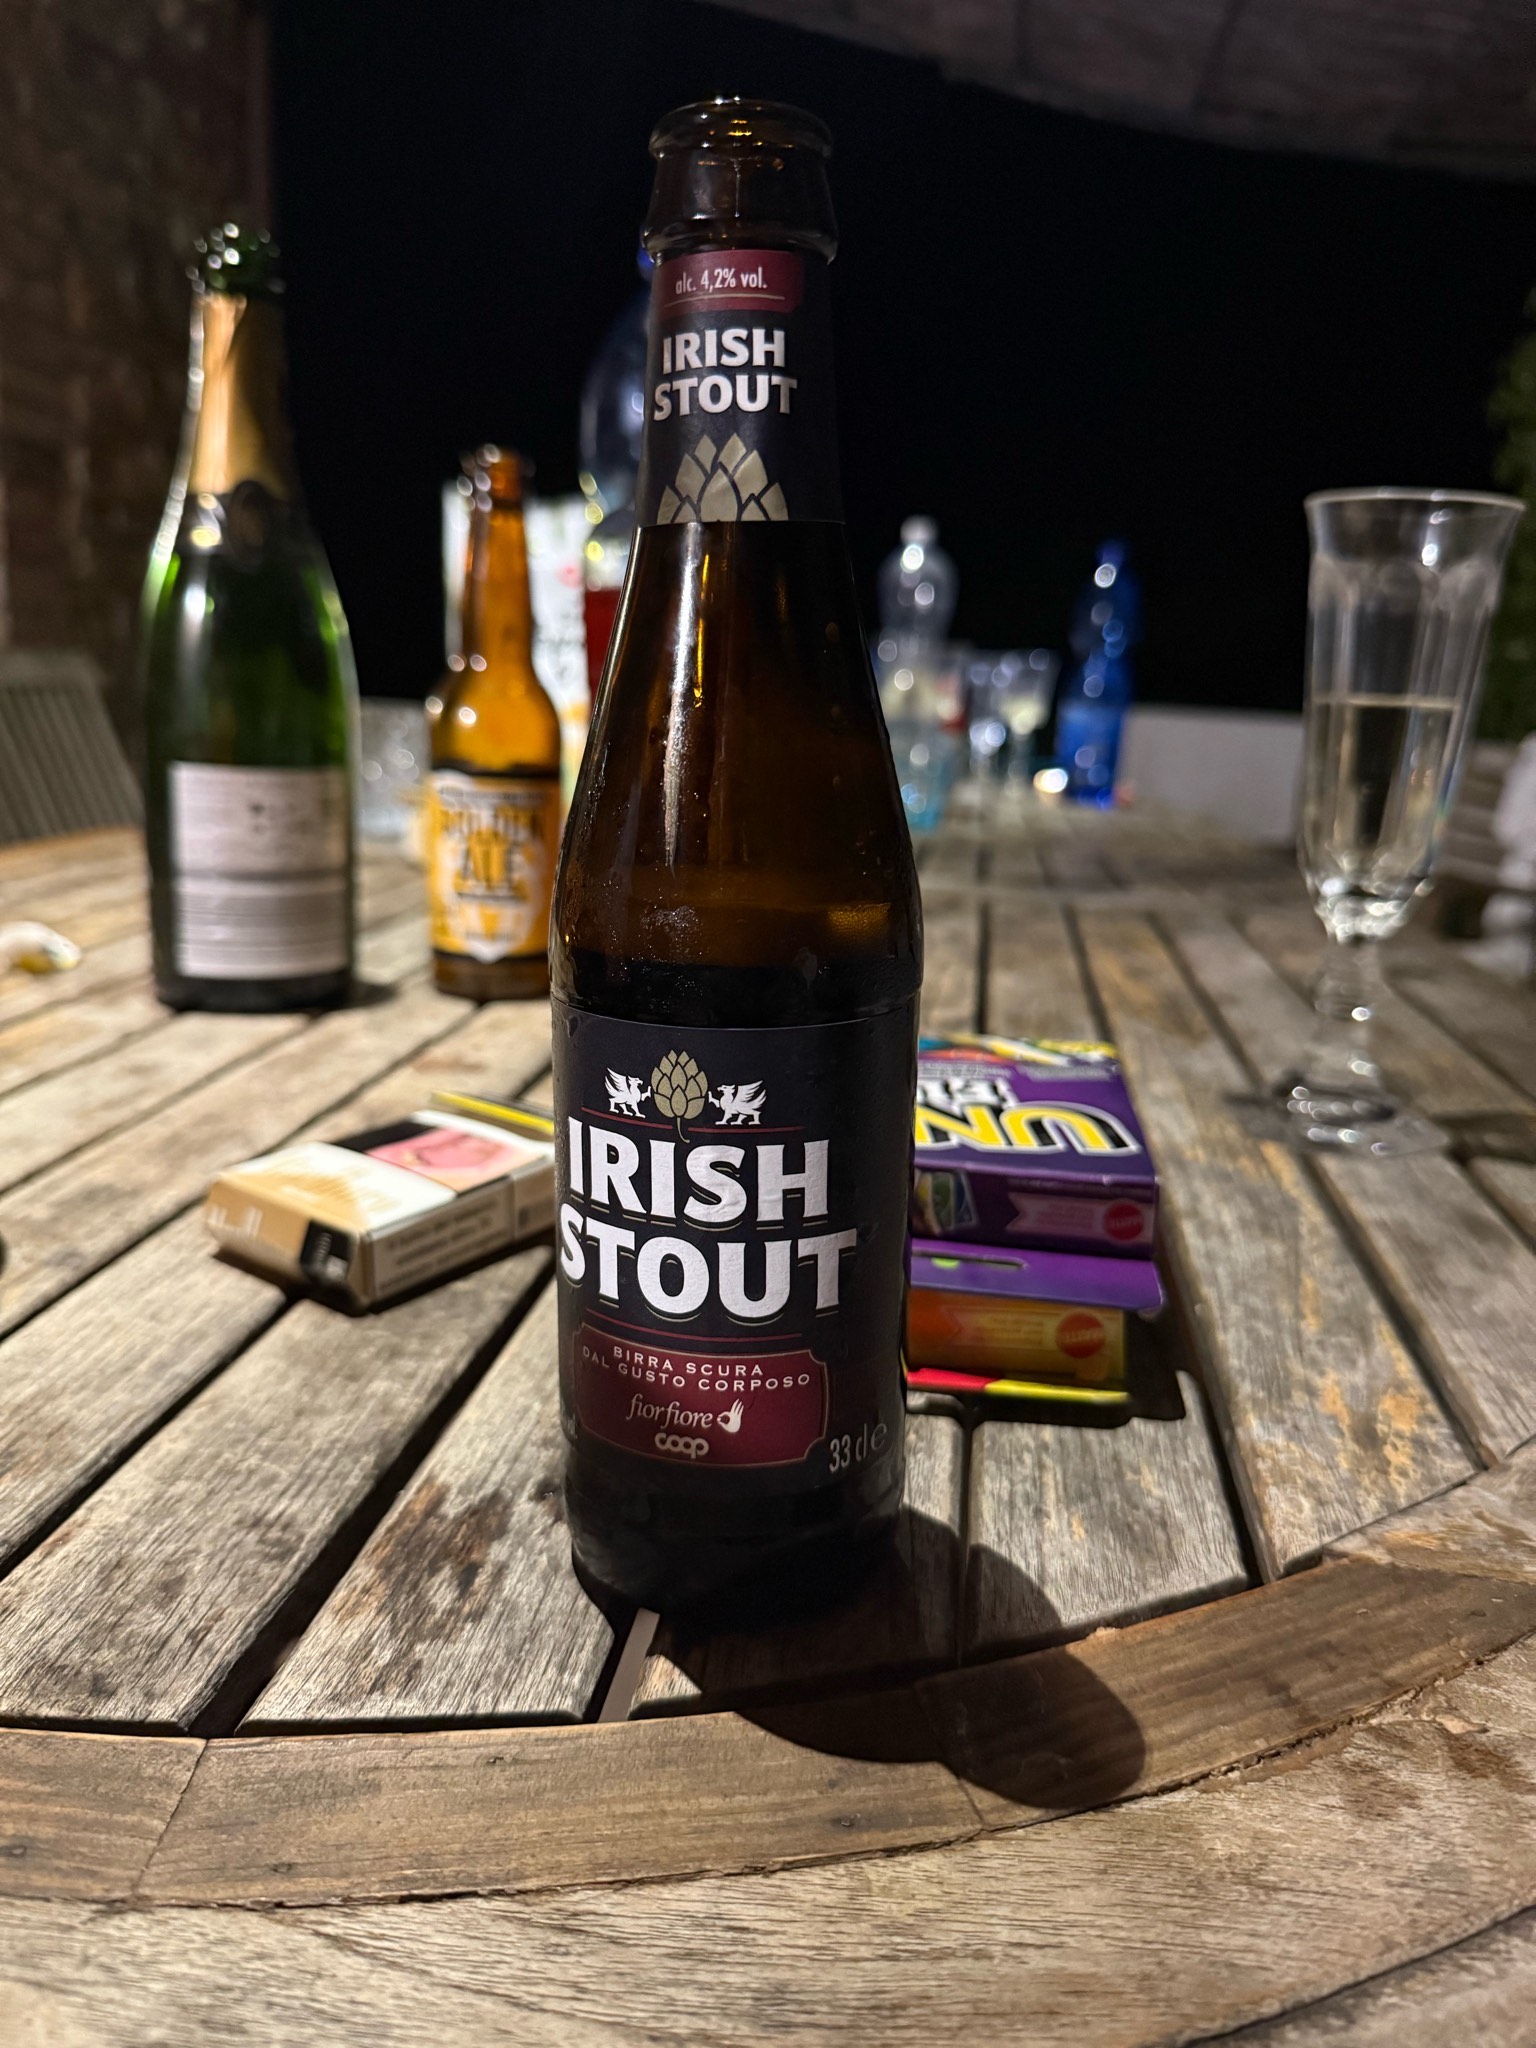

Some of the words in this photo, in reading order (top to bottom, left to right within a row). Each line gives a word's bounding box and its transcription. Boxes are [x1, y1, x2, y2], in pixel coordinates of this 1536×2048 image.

[675, 272, 697, 295] alc.
[701, 267, 736, 293] 4,2%
[739, 266, 768, 289] vol.
[662, 328, 786, 375] IRISH
[653, 373, 798, 422] STOUT
[914, 1101, 1139, 1155] UN
[567, 1115, 830, 1226] IRISH
[560, 1202, 858, 1321] STOUT
[582, 1344, 610, 1368] DAL
[618, 1362, 686, 1388] GUSTO
[697, 1373, 810, 1392] CORPOSO
[613, 1345, 674, 1372] BIRRA
[685, 1361, 764, 1377] SCURA
[654, 1431, 710, 1459] coop
[829, 1434, 851, 1473] 33
[855, 1423, 867, 1462] cl
